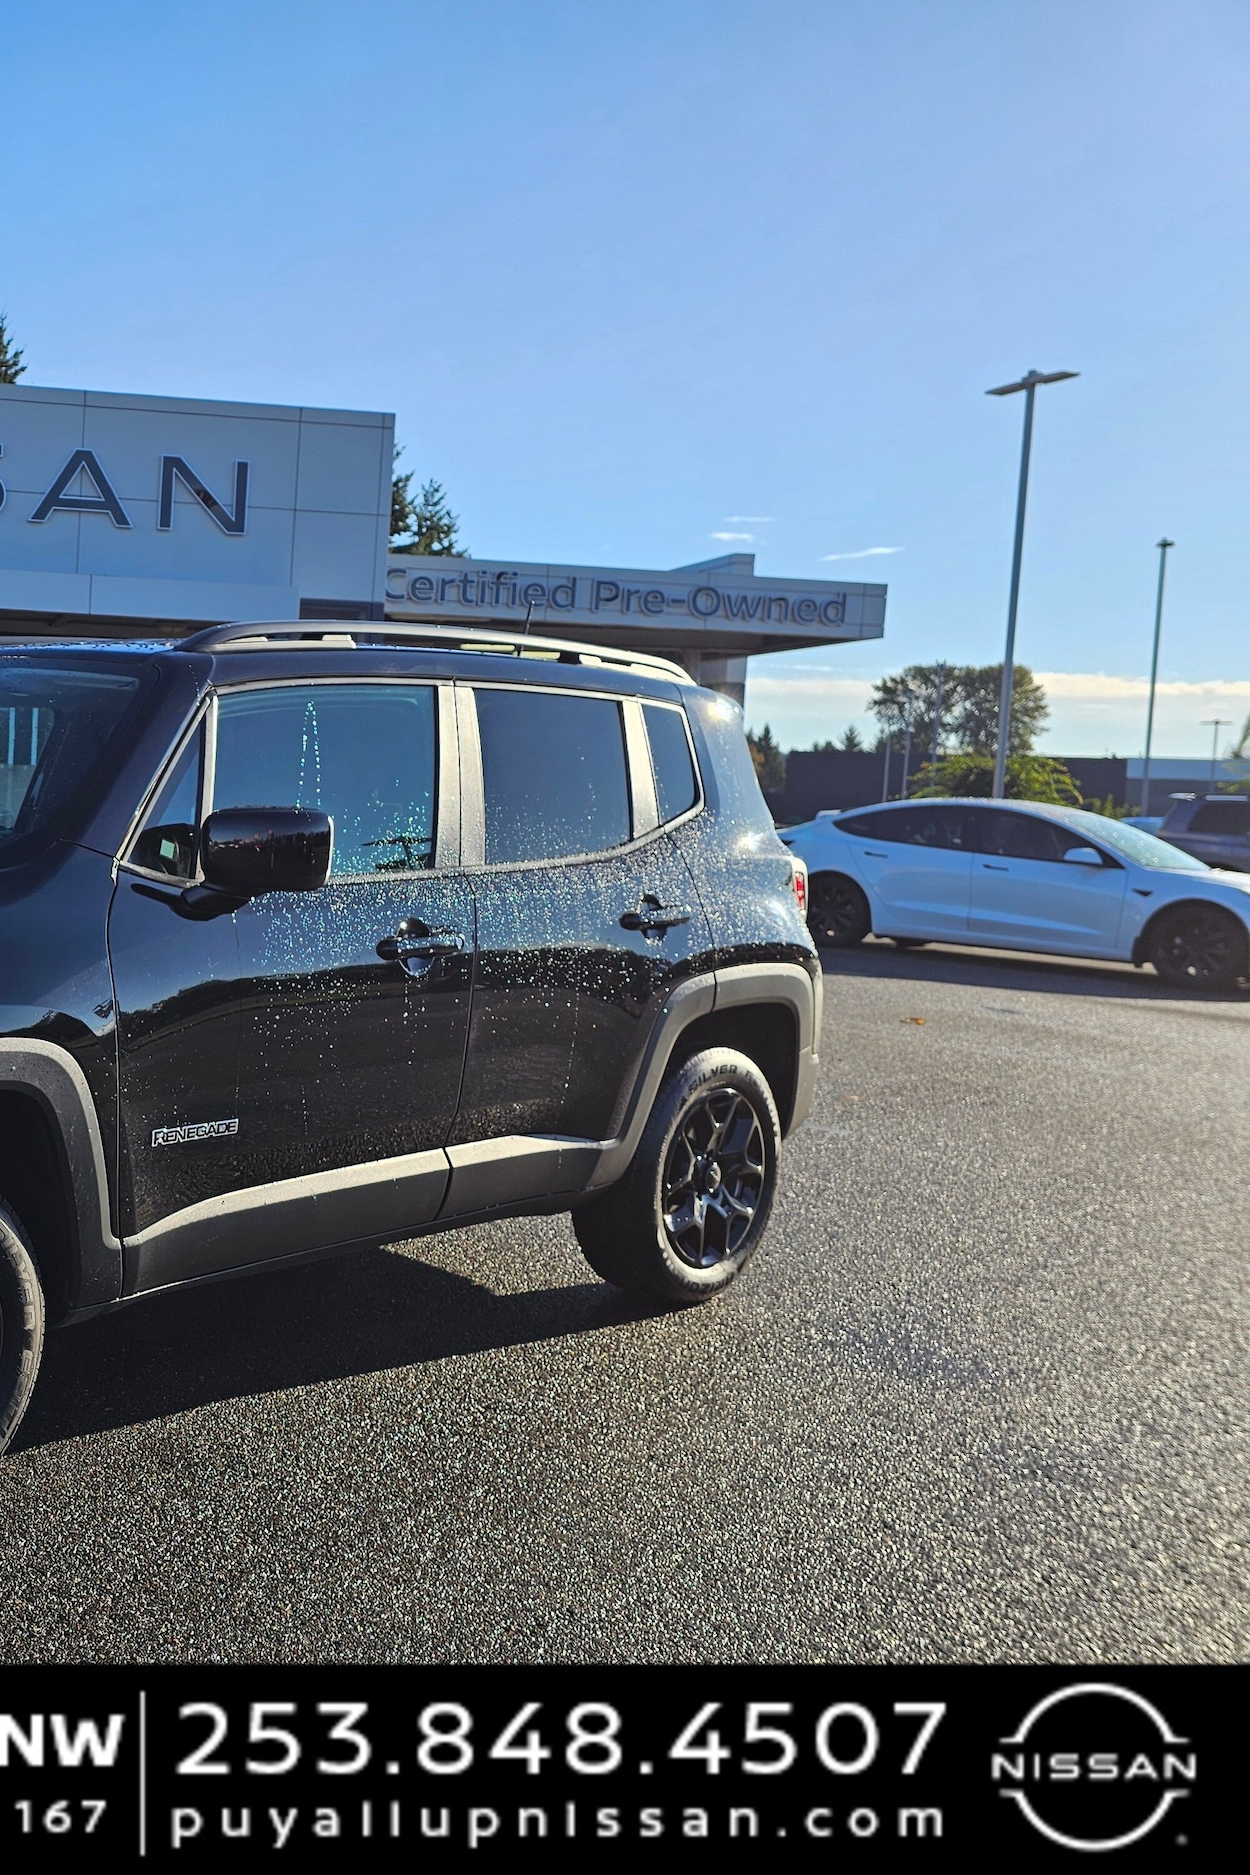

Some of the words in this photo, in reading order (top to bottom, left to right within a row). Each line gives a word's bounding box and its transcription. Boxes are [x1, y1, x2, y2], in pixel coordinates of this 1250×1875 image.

[385, 566, 577, 609] Certified
[592, 580, 847, 626] Pre-Owned
[688, 1064, 739, 1095] SILVER
[151, 1118, 240, 1148] RENEGADE
